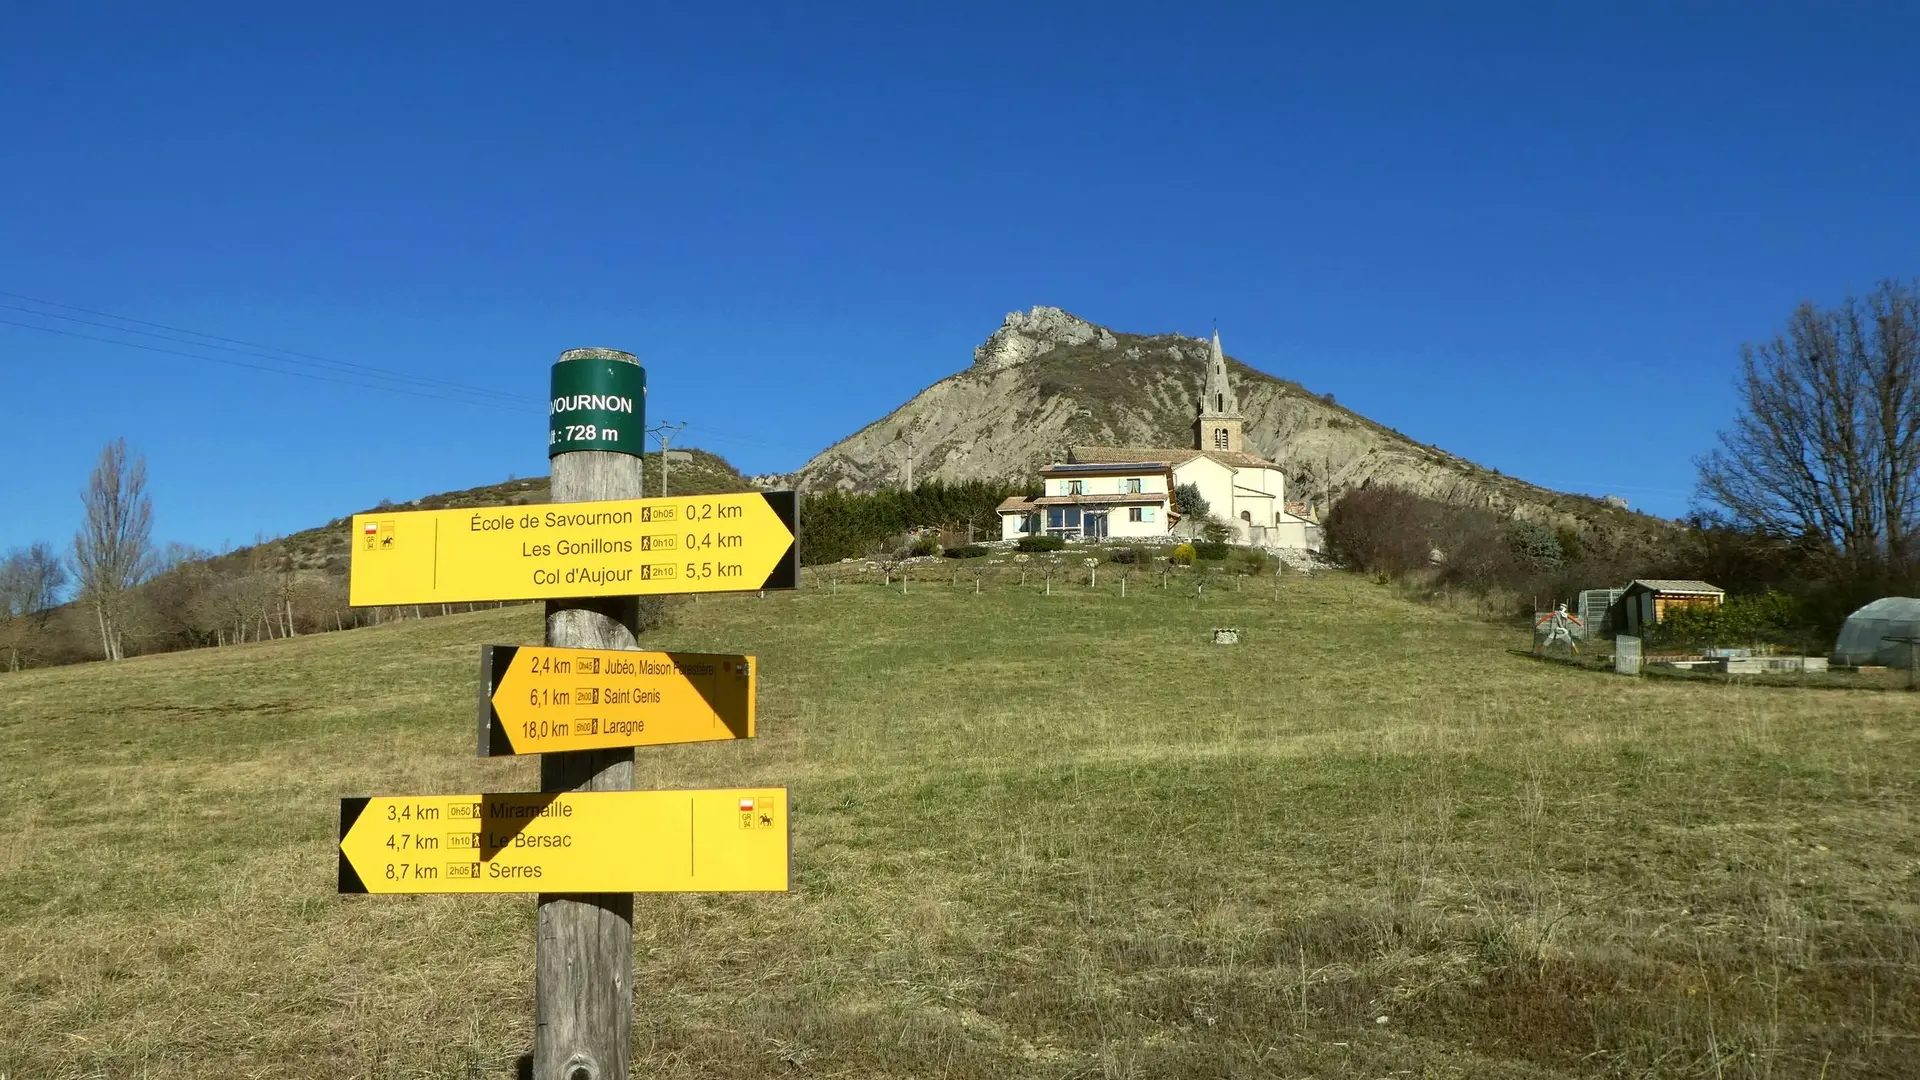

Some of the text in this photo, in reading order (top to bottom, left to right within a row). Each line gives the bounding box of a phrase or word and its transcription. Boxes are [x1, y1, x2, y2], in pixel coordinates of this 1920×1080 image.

[549, 395, 632, 415] VOURNON
[566, 425, 596, 441] 728
[602, 428, 618, 441] m
[471, 503, 742, 531] École de Savournon 0h05 0,2 km
[522, 532, 742, 557] Les Gonillons 0h10 0,4 km
[533, 561, 742, 586] Col d'Aujour 2h10 5,5 km
[531, 657, 550, 676] 2,4
[554, 658, 571, 674] km
[578, 661, 593, 671] 0h45
[604, 658, 637, 678] Jubéo,
[639, 660, 671, 675] Maison
[530, 688, 661, 708] 6,1 km 2h00 Saint Genis
[522, 720, 548, 740] 18,0
[552, 720, 569, 736] km
[603, 718, 644, 737] Laragne
[387, 801, 572, 822] 3,4 km 0h50 Miramaille
[386, 832, 572, 851] 4,7 km 1h10 Le Bersac
[385, 862, 542, 881] 8,7 km 2h05 Serres
